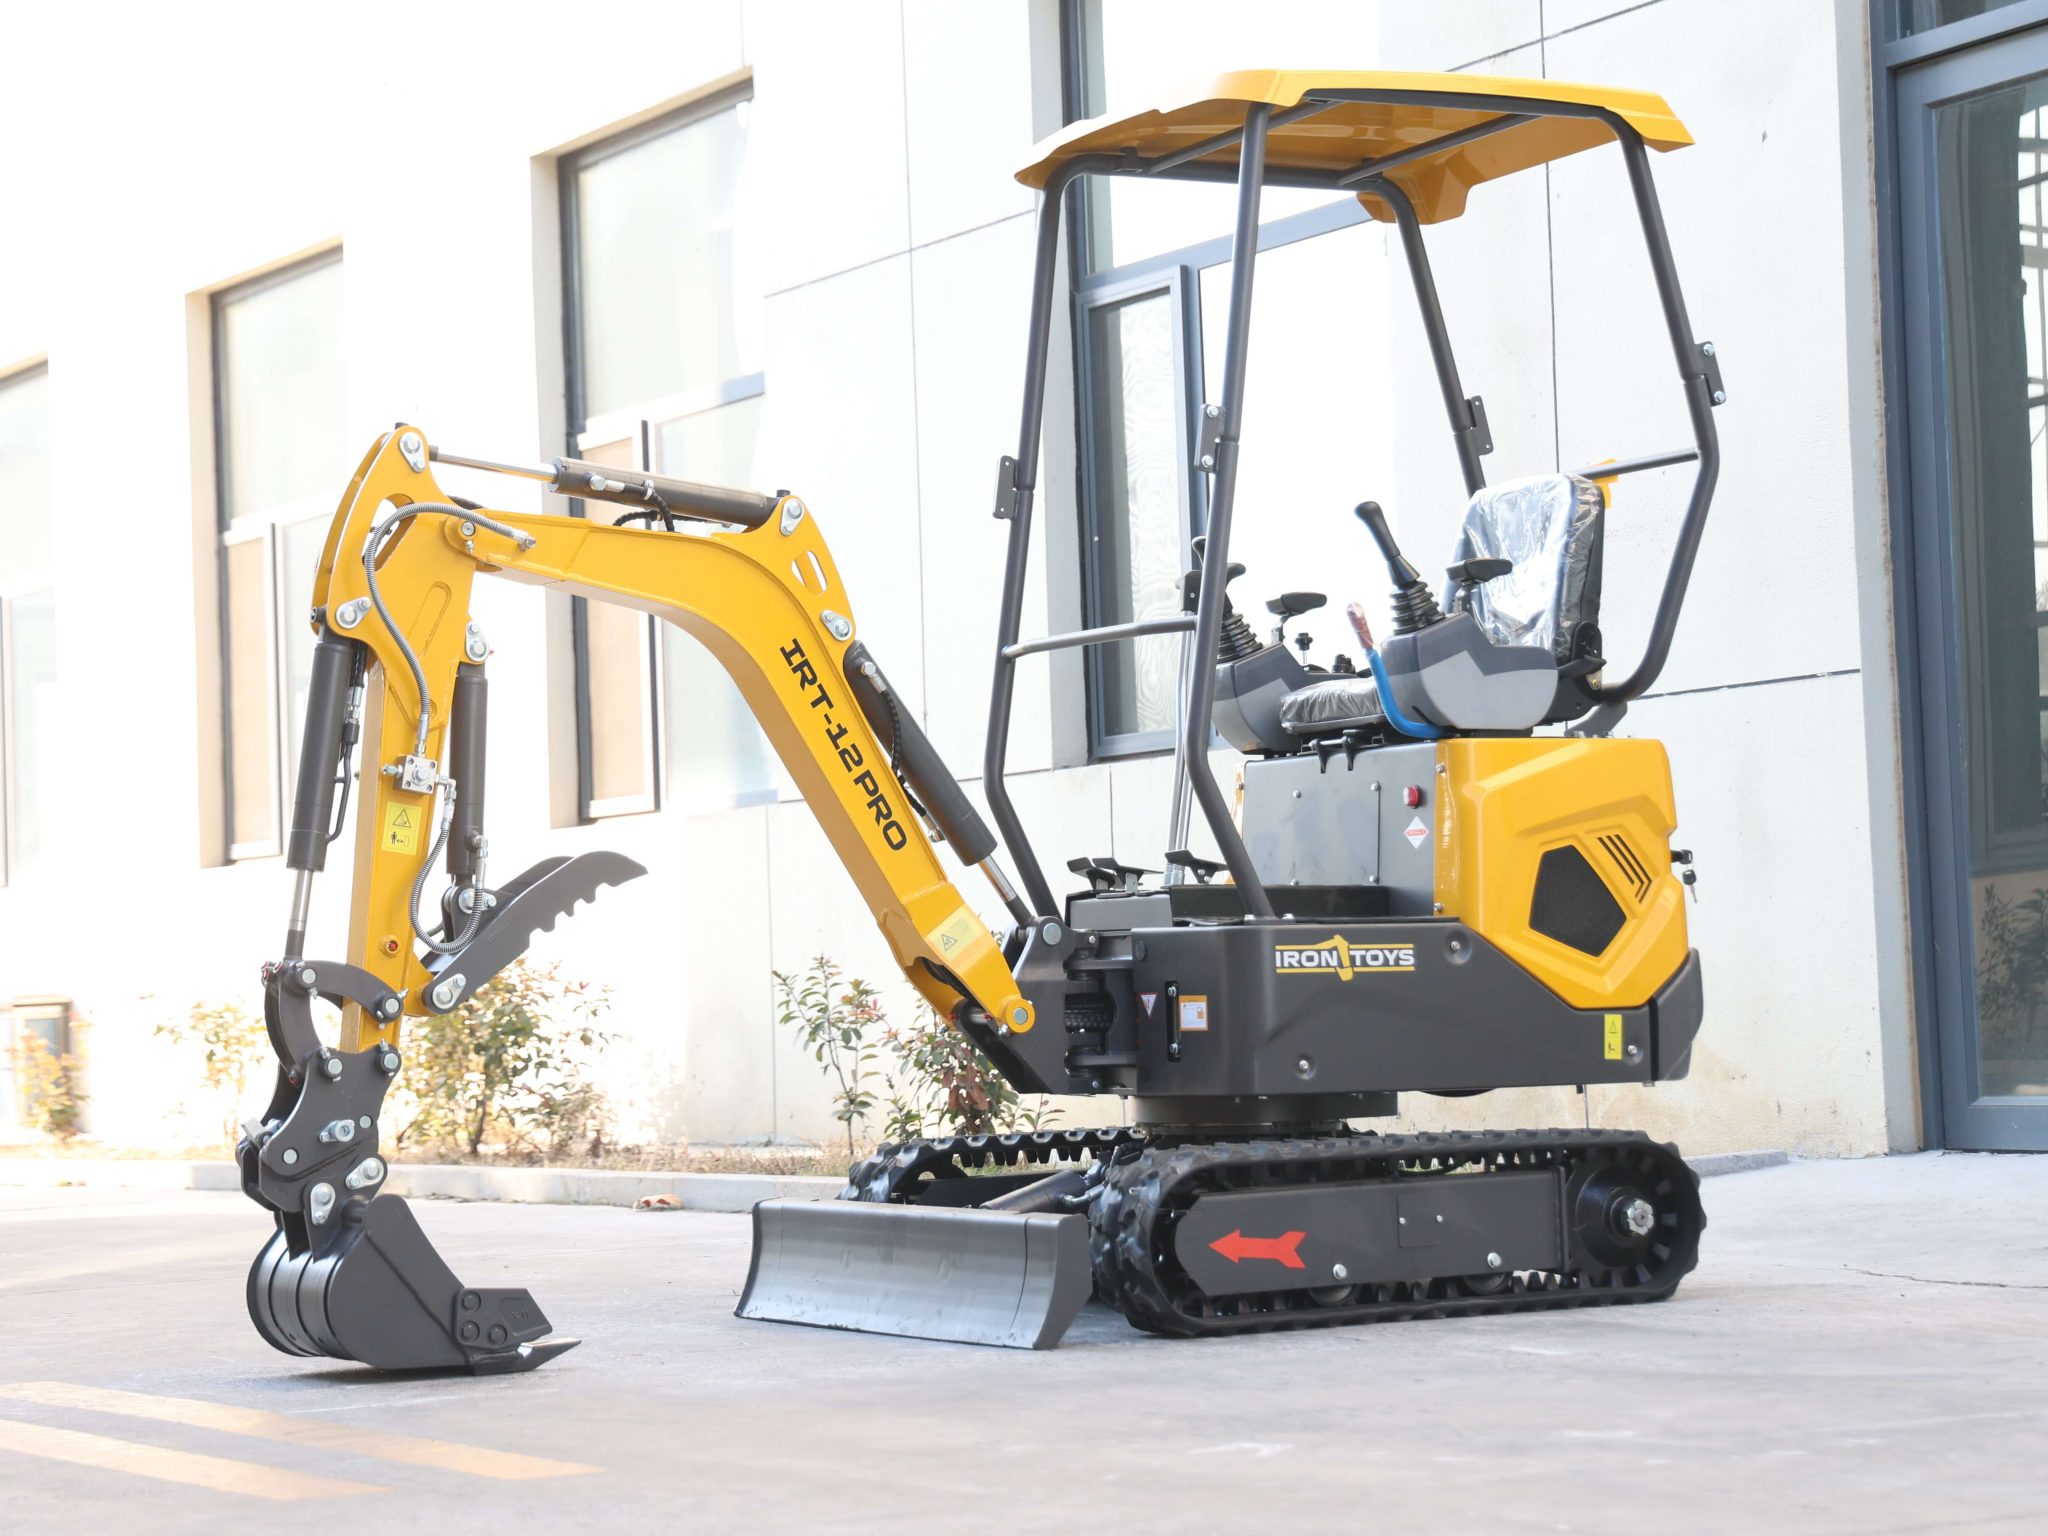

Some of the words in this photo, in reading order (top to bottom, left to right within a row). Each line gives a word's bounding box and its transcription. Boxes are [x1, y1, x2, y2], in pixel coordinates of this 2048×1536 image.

[780, 638, 864, 773] IRT-12
[853, 769, 907, 851] PRO
[1275, 950, 1338, 967] IRON
[1349, 949, 1415, 966] TOYS
